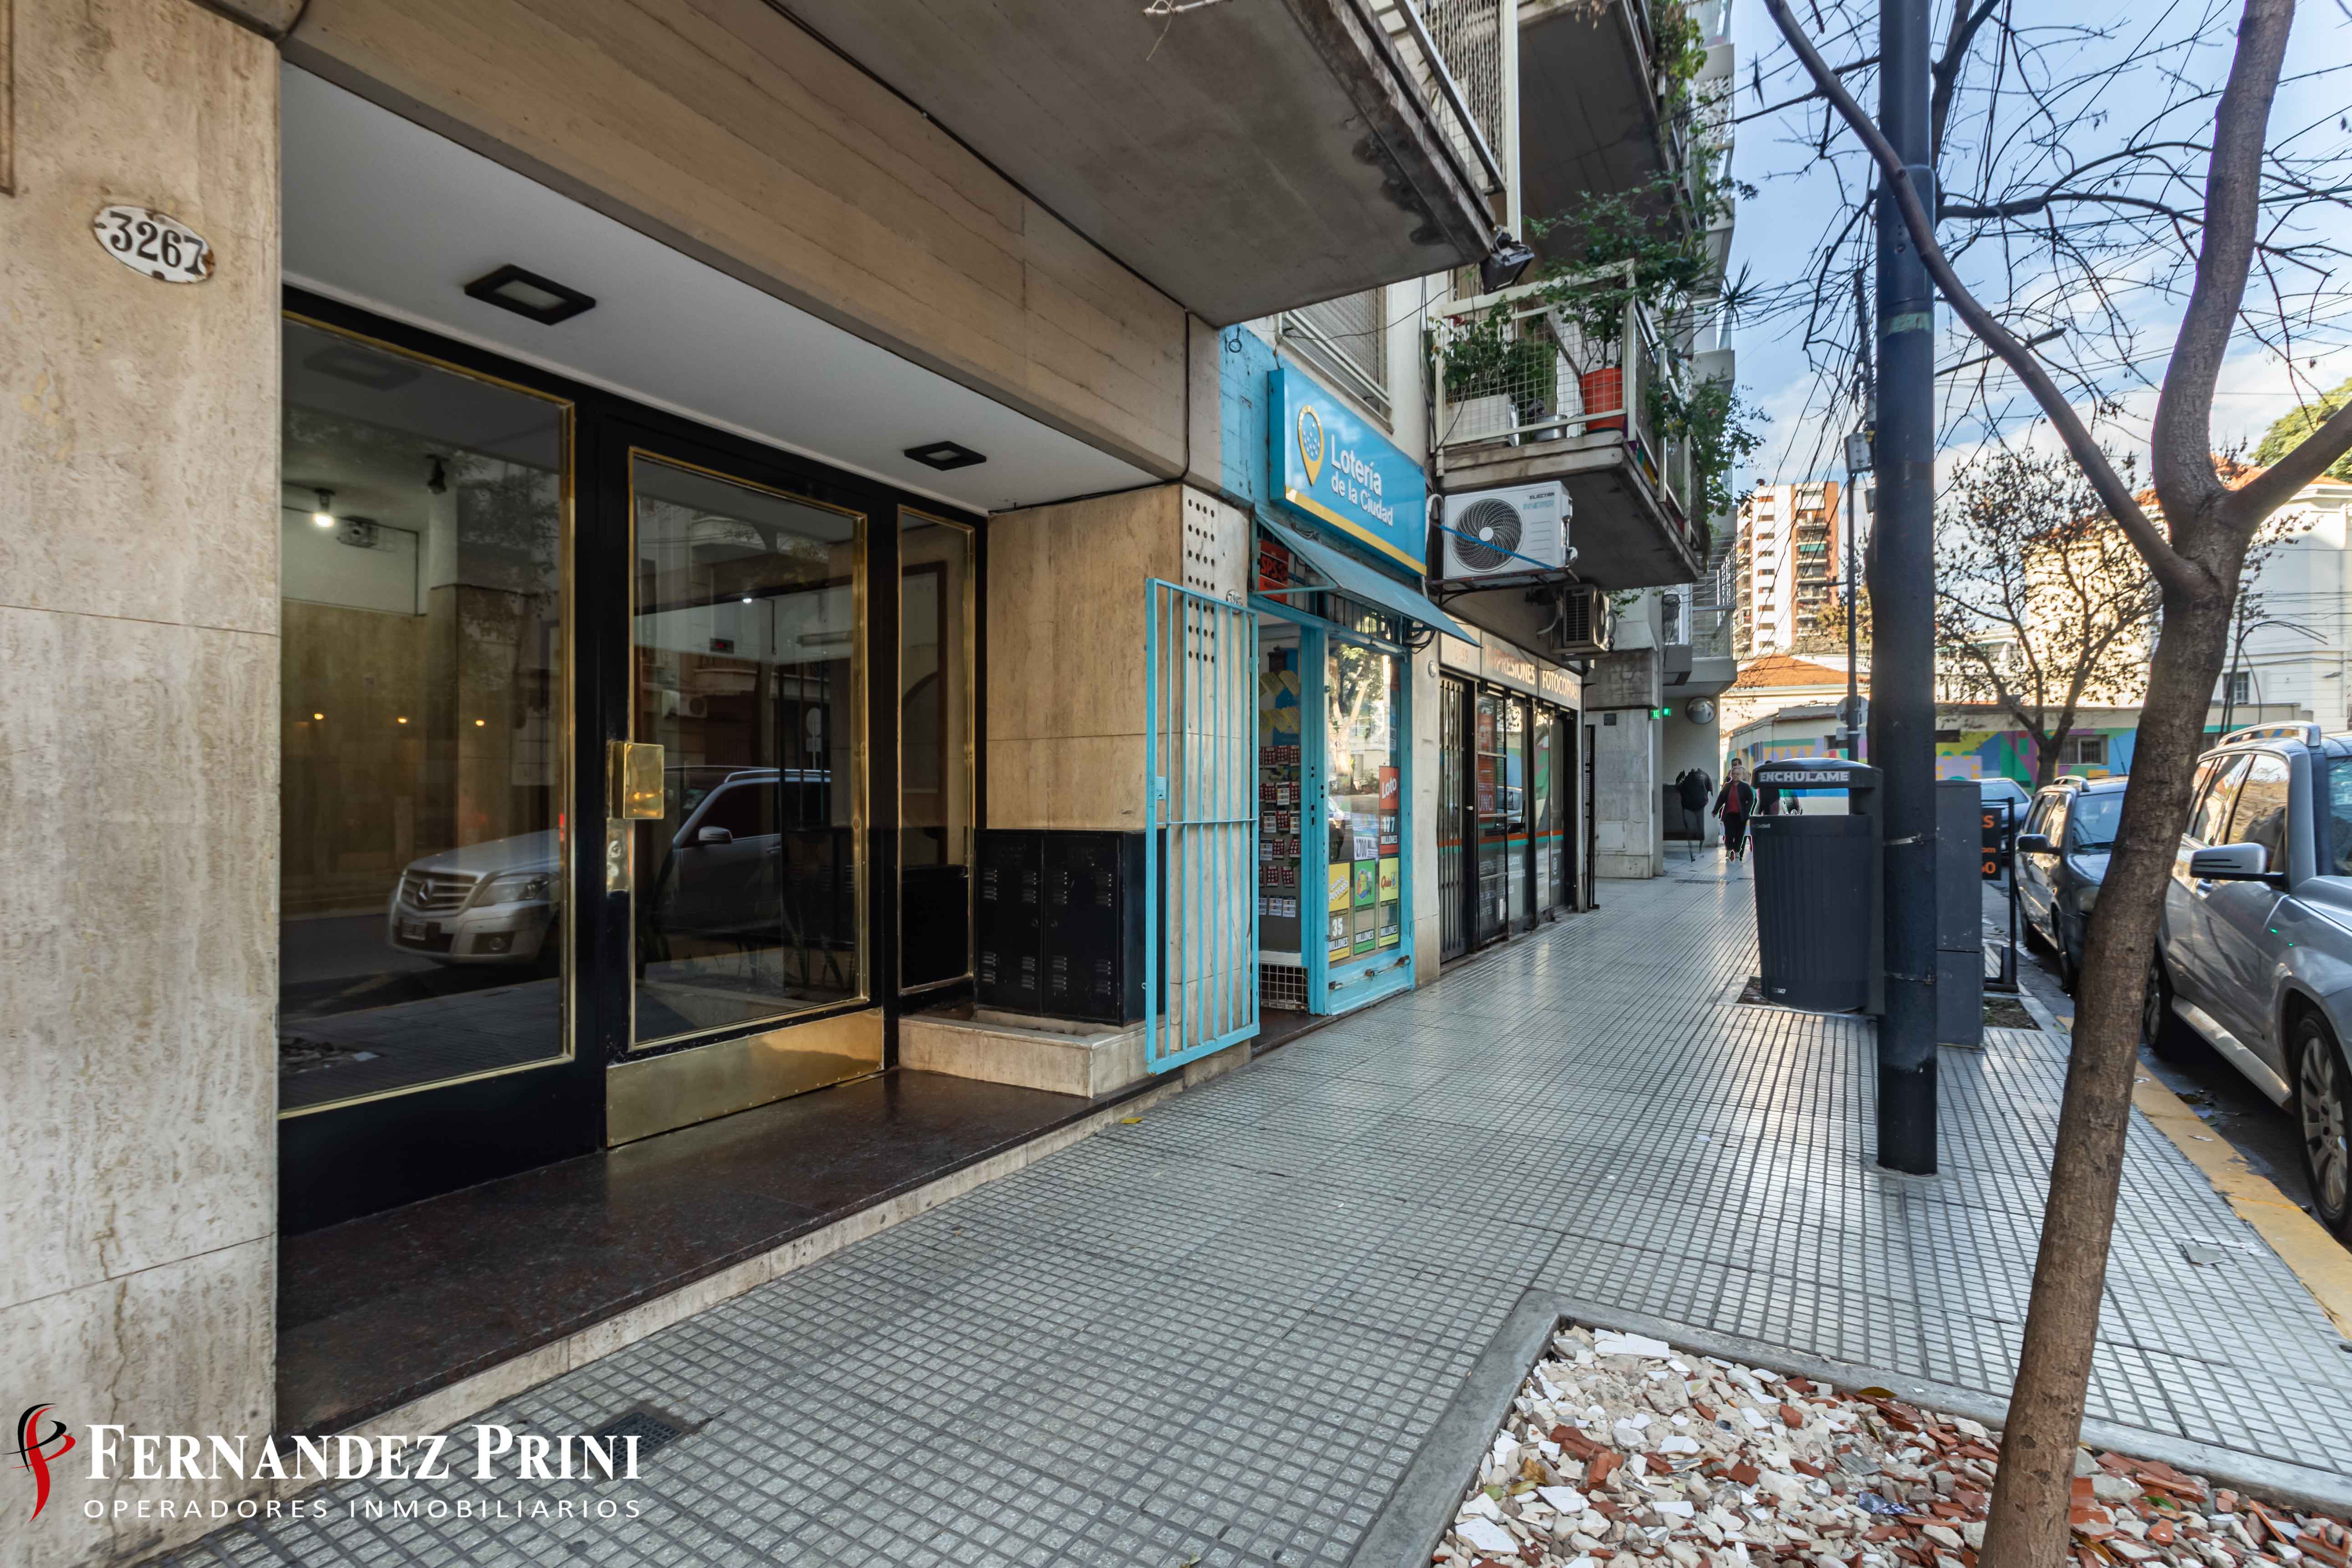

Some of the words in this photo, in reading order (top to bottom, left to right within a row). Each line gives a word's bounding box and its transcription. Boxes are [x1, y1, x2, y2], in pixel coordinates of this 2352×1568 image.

[109, 210, 204, 276] 3267
[1330, 434, 1382, 496] Lotería
[1331, 471, 1346, 497] de
[1349, 479, 1358, 506] la
[1360, 489, 1394, 527] Ciudad
[1486, 645, 1535, 685] IMPRESIONES
[1542, 670, 1578, 700] FOTOCOPIAS
[1382, 778, 1397, 799] Loto
[1760, 772, 1850, 782] ENCHULAME
[1333, 918, 1343, 937] 35
